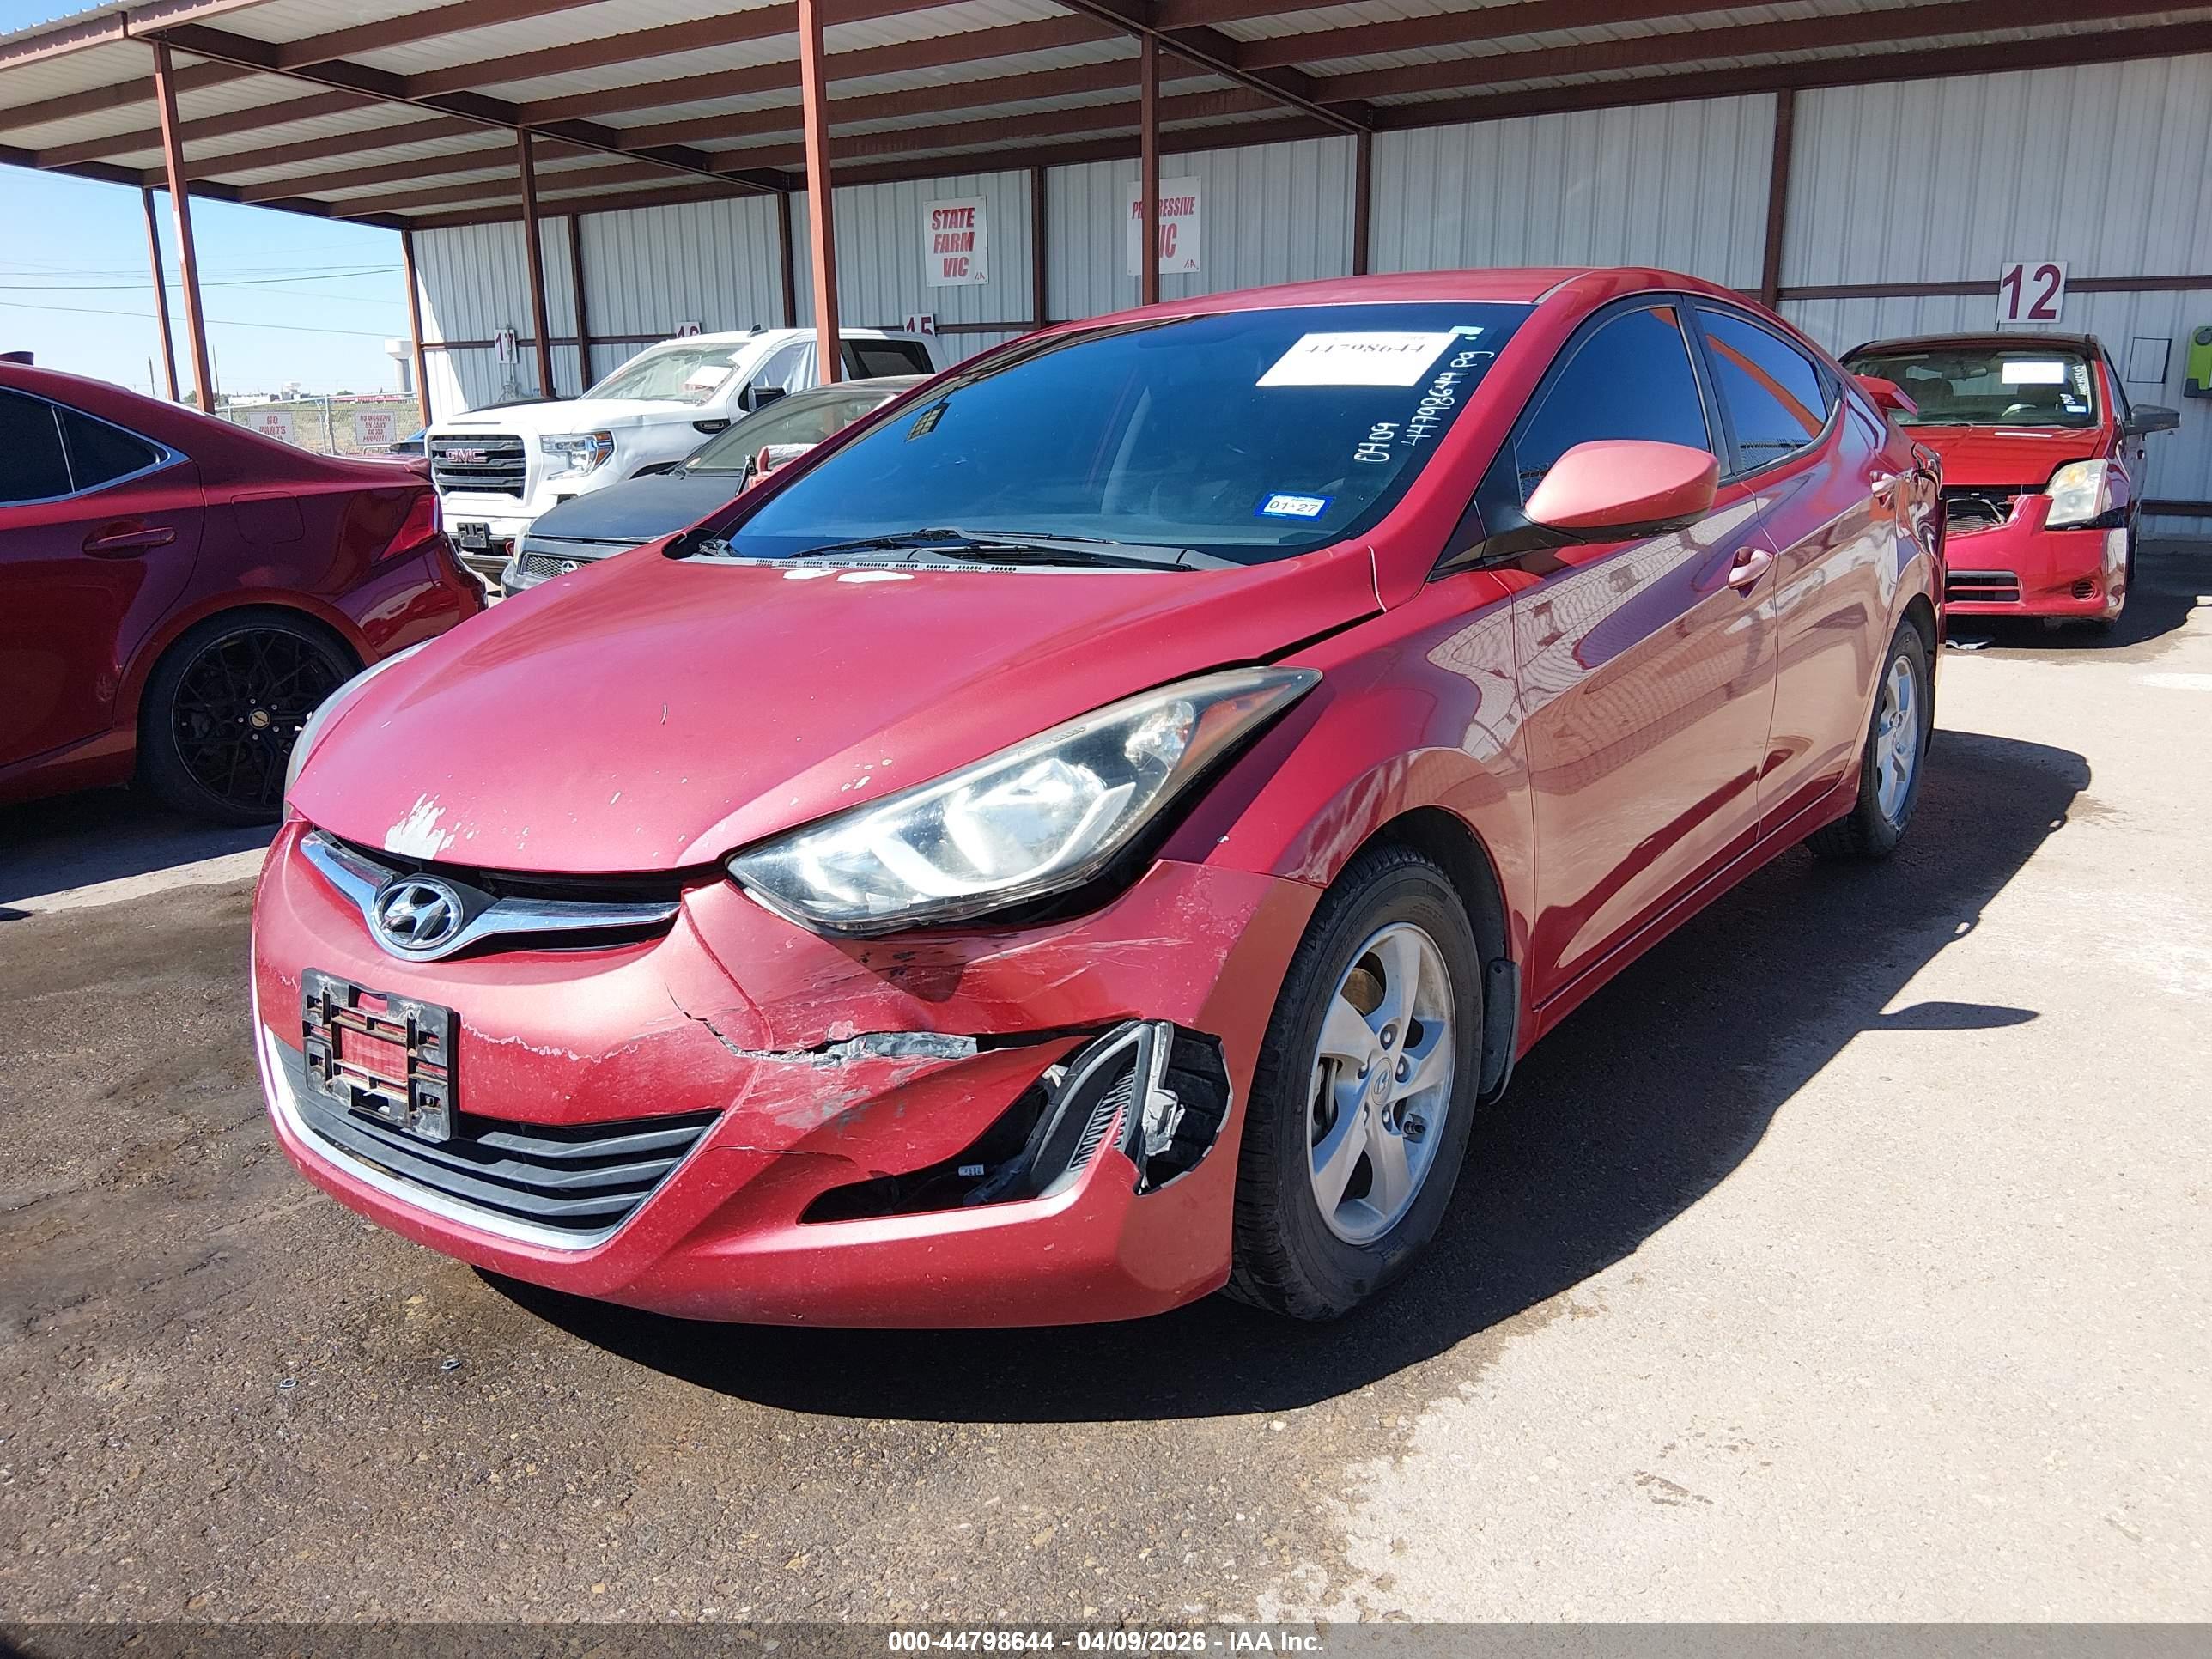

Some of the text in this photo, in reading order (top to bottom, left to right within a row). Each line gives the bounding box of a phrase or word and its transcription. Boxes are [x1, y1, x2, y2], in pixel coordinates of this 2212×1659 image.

[931, 207, 976, 231] STATE
[1132, 197, 1194, 220] PRRESSIVE
[933, 231, 975, 254] FARM
[1159, 222, 1177, 259] IC
[943, 256, 969, 278] VIC
[2002, 263, 2062, 319] 12
[446, 447, 489, 463] GMC
